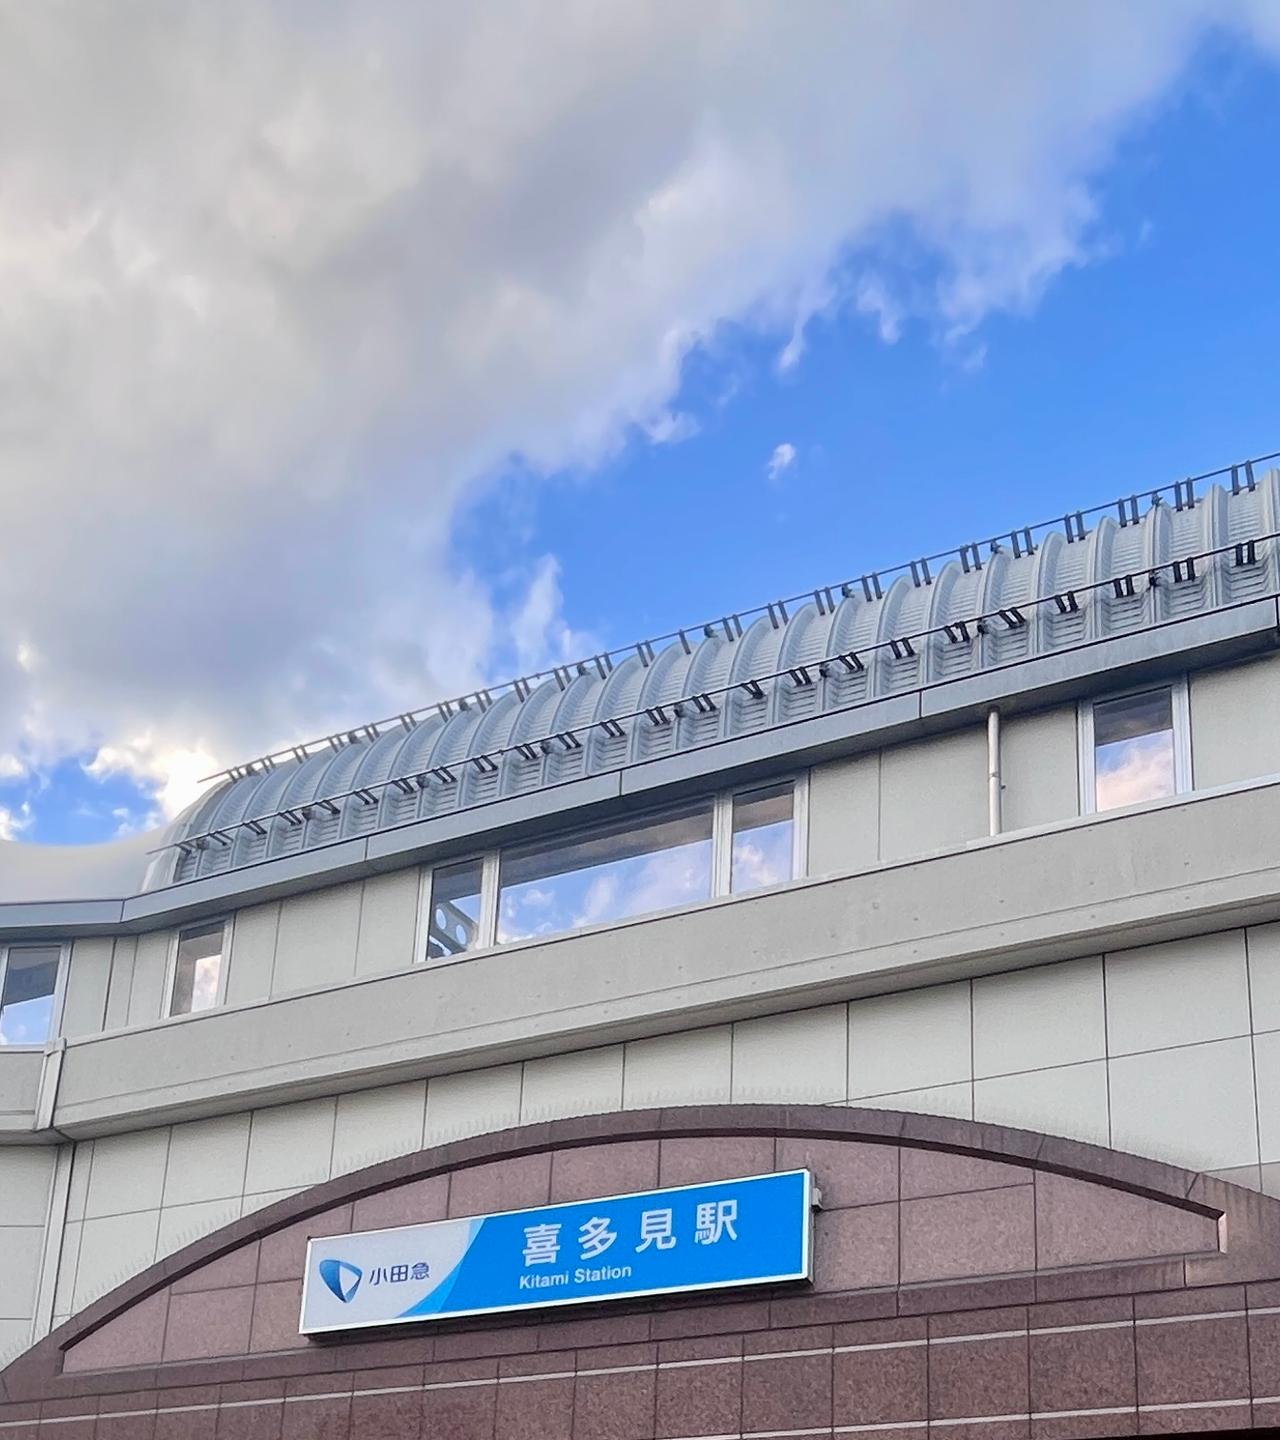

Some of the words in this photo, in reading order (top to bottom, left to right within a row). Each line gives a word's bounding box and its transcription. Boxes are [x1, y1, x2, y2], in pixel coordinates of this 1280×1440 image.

[521, 1199, 738, 1267] 喜多見駅
[369, 1261, 430, 1286] 小田急
[519, 1270, 569, 1290] Kitami
[574, 1264, 632, 1285] Station
